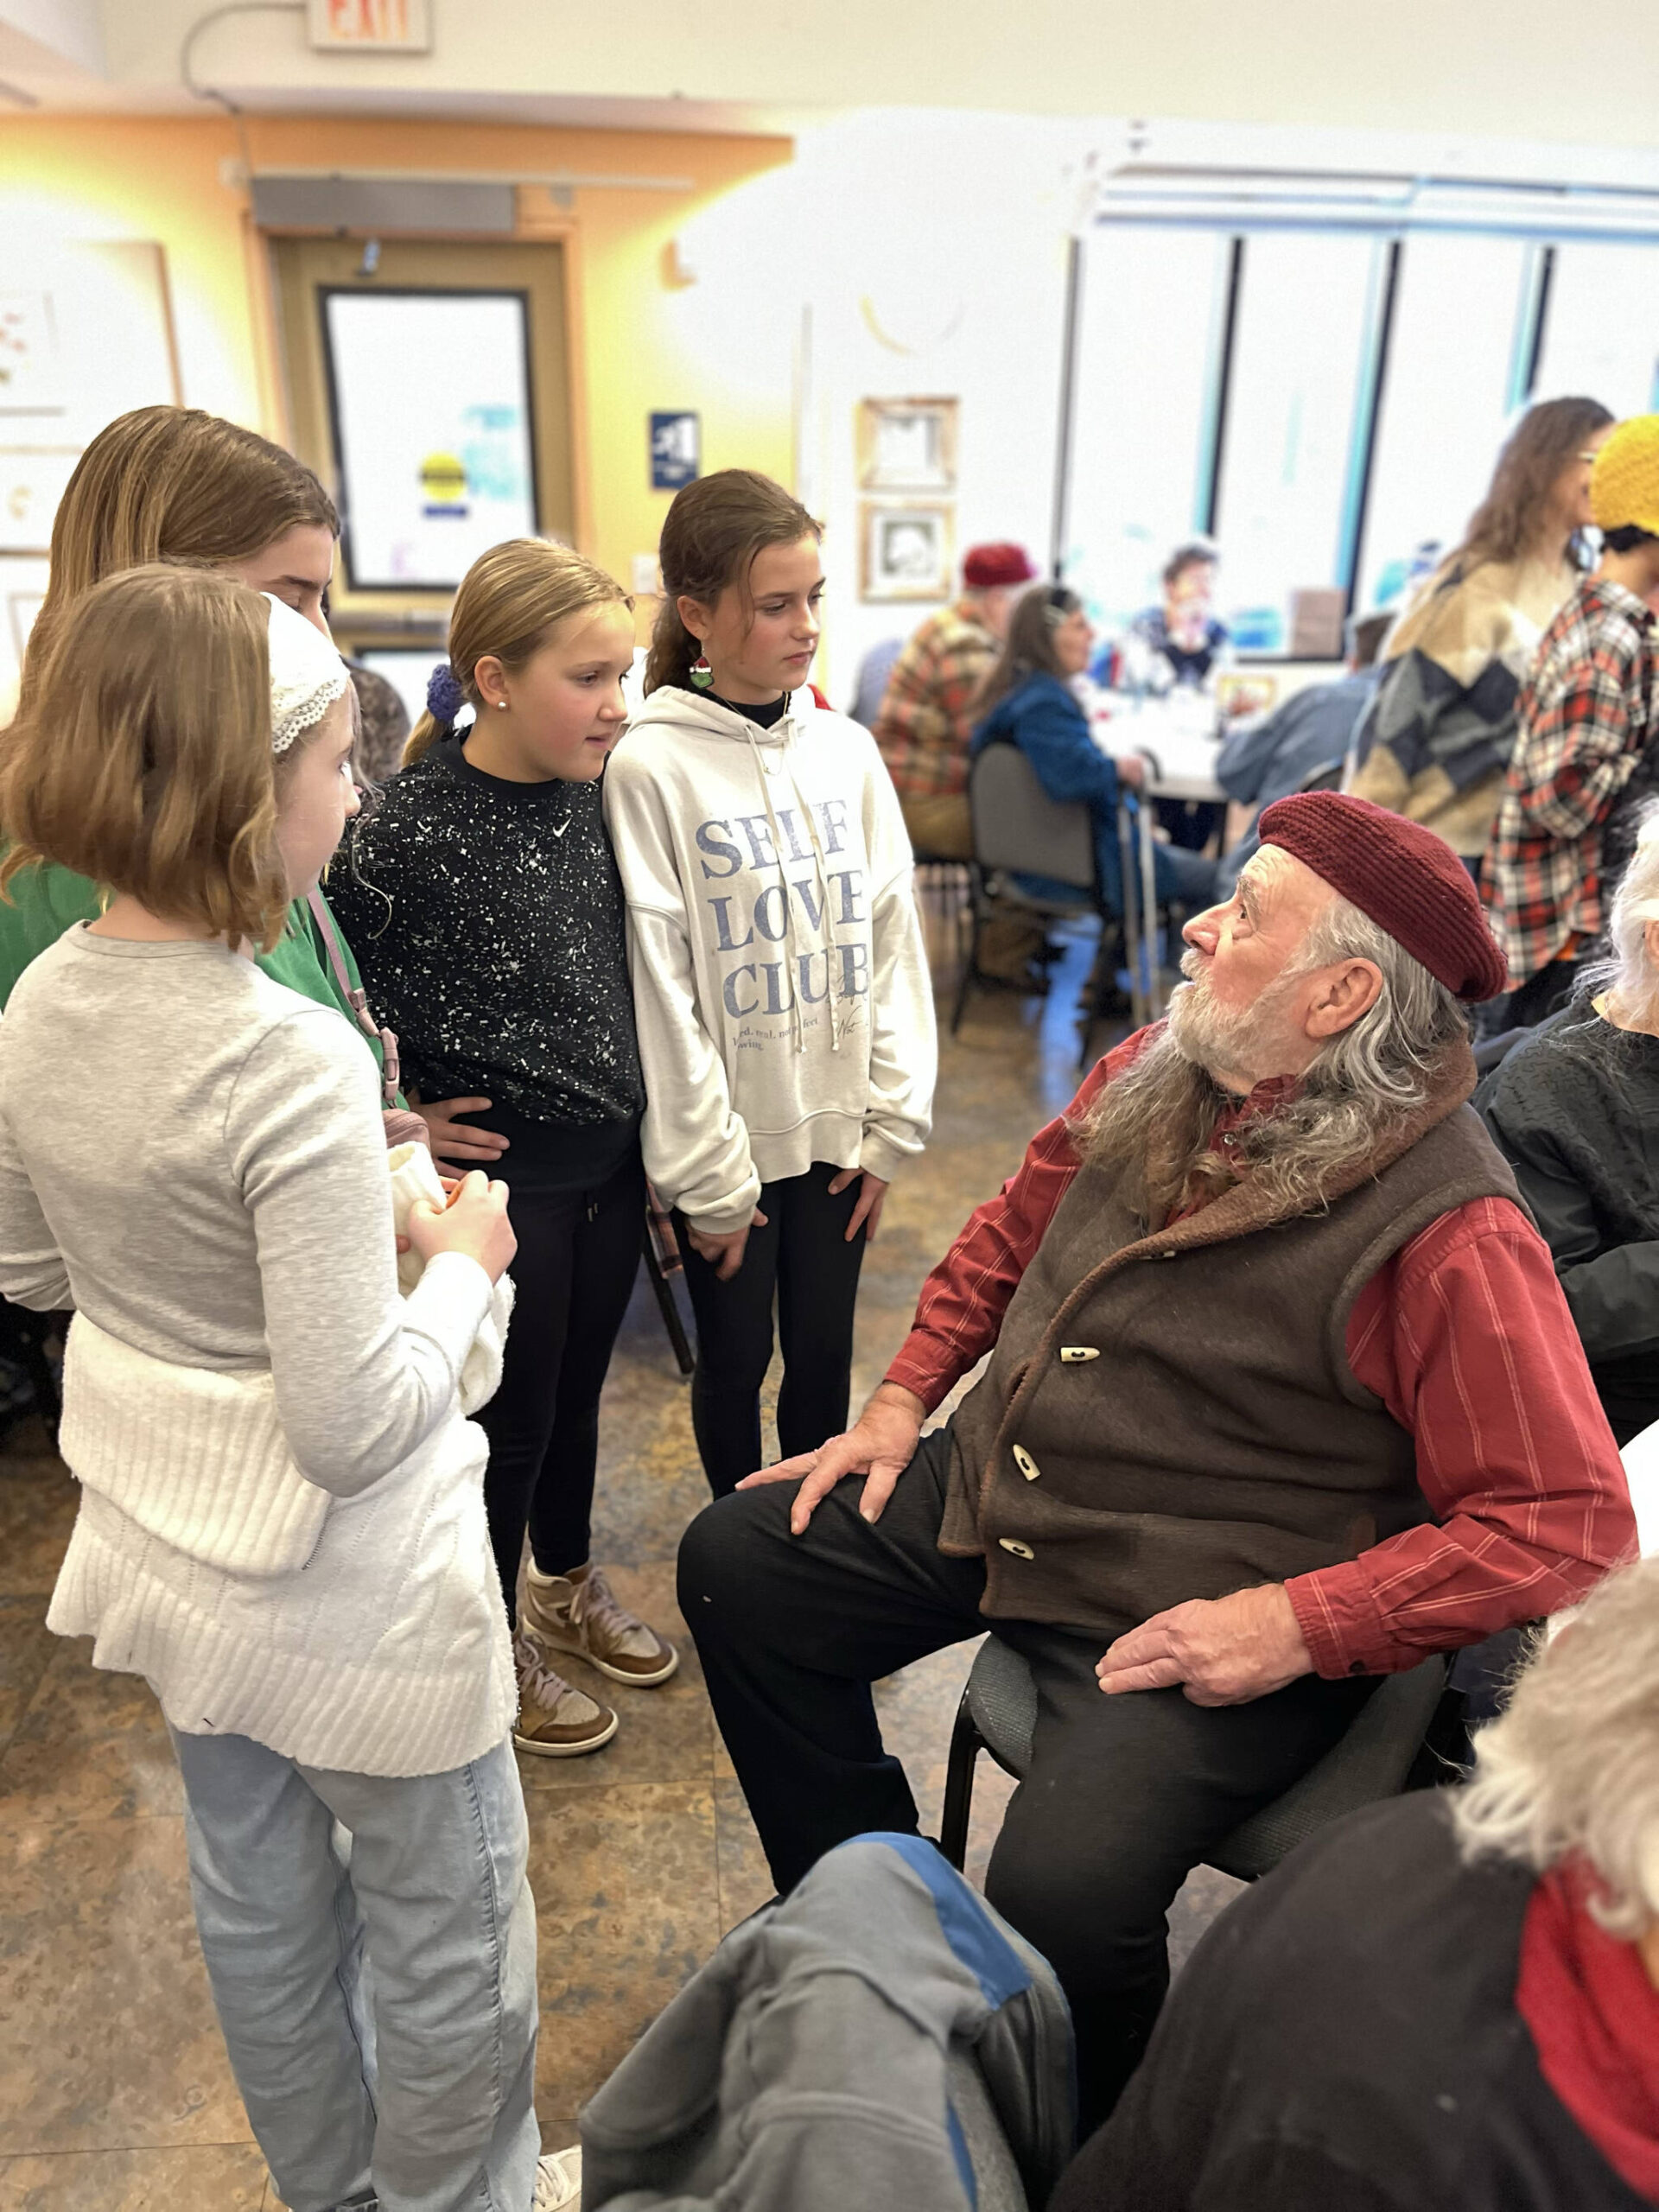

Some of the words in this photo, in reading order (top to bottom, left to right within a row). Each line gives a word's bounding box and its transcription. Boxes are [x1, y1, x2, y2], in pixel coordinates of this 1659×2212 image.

[696, 799, 848, 880] SELF
[708, 869, 866, 951] LOVE
[723, 943, 870, 1019] CLUB
